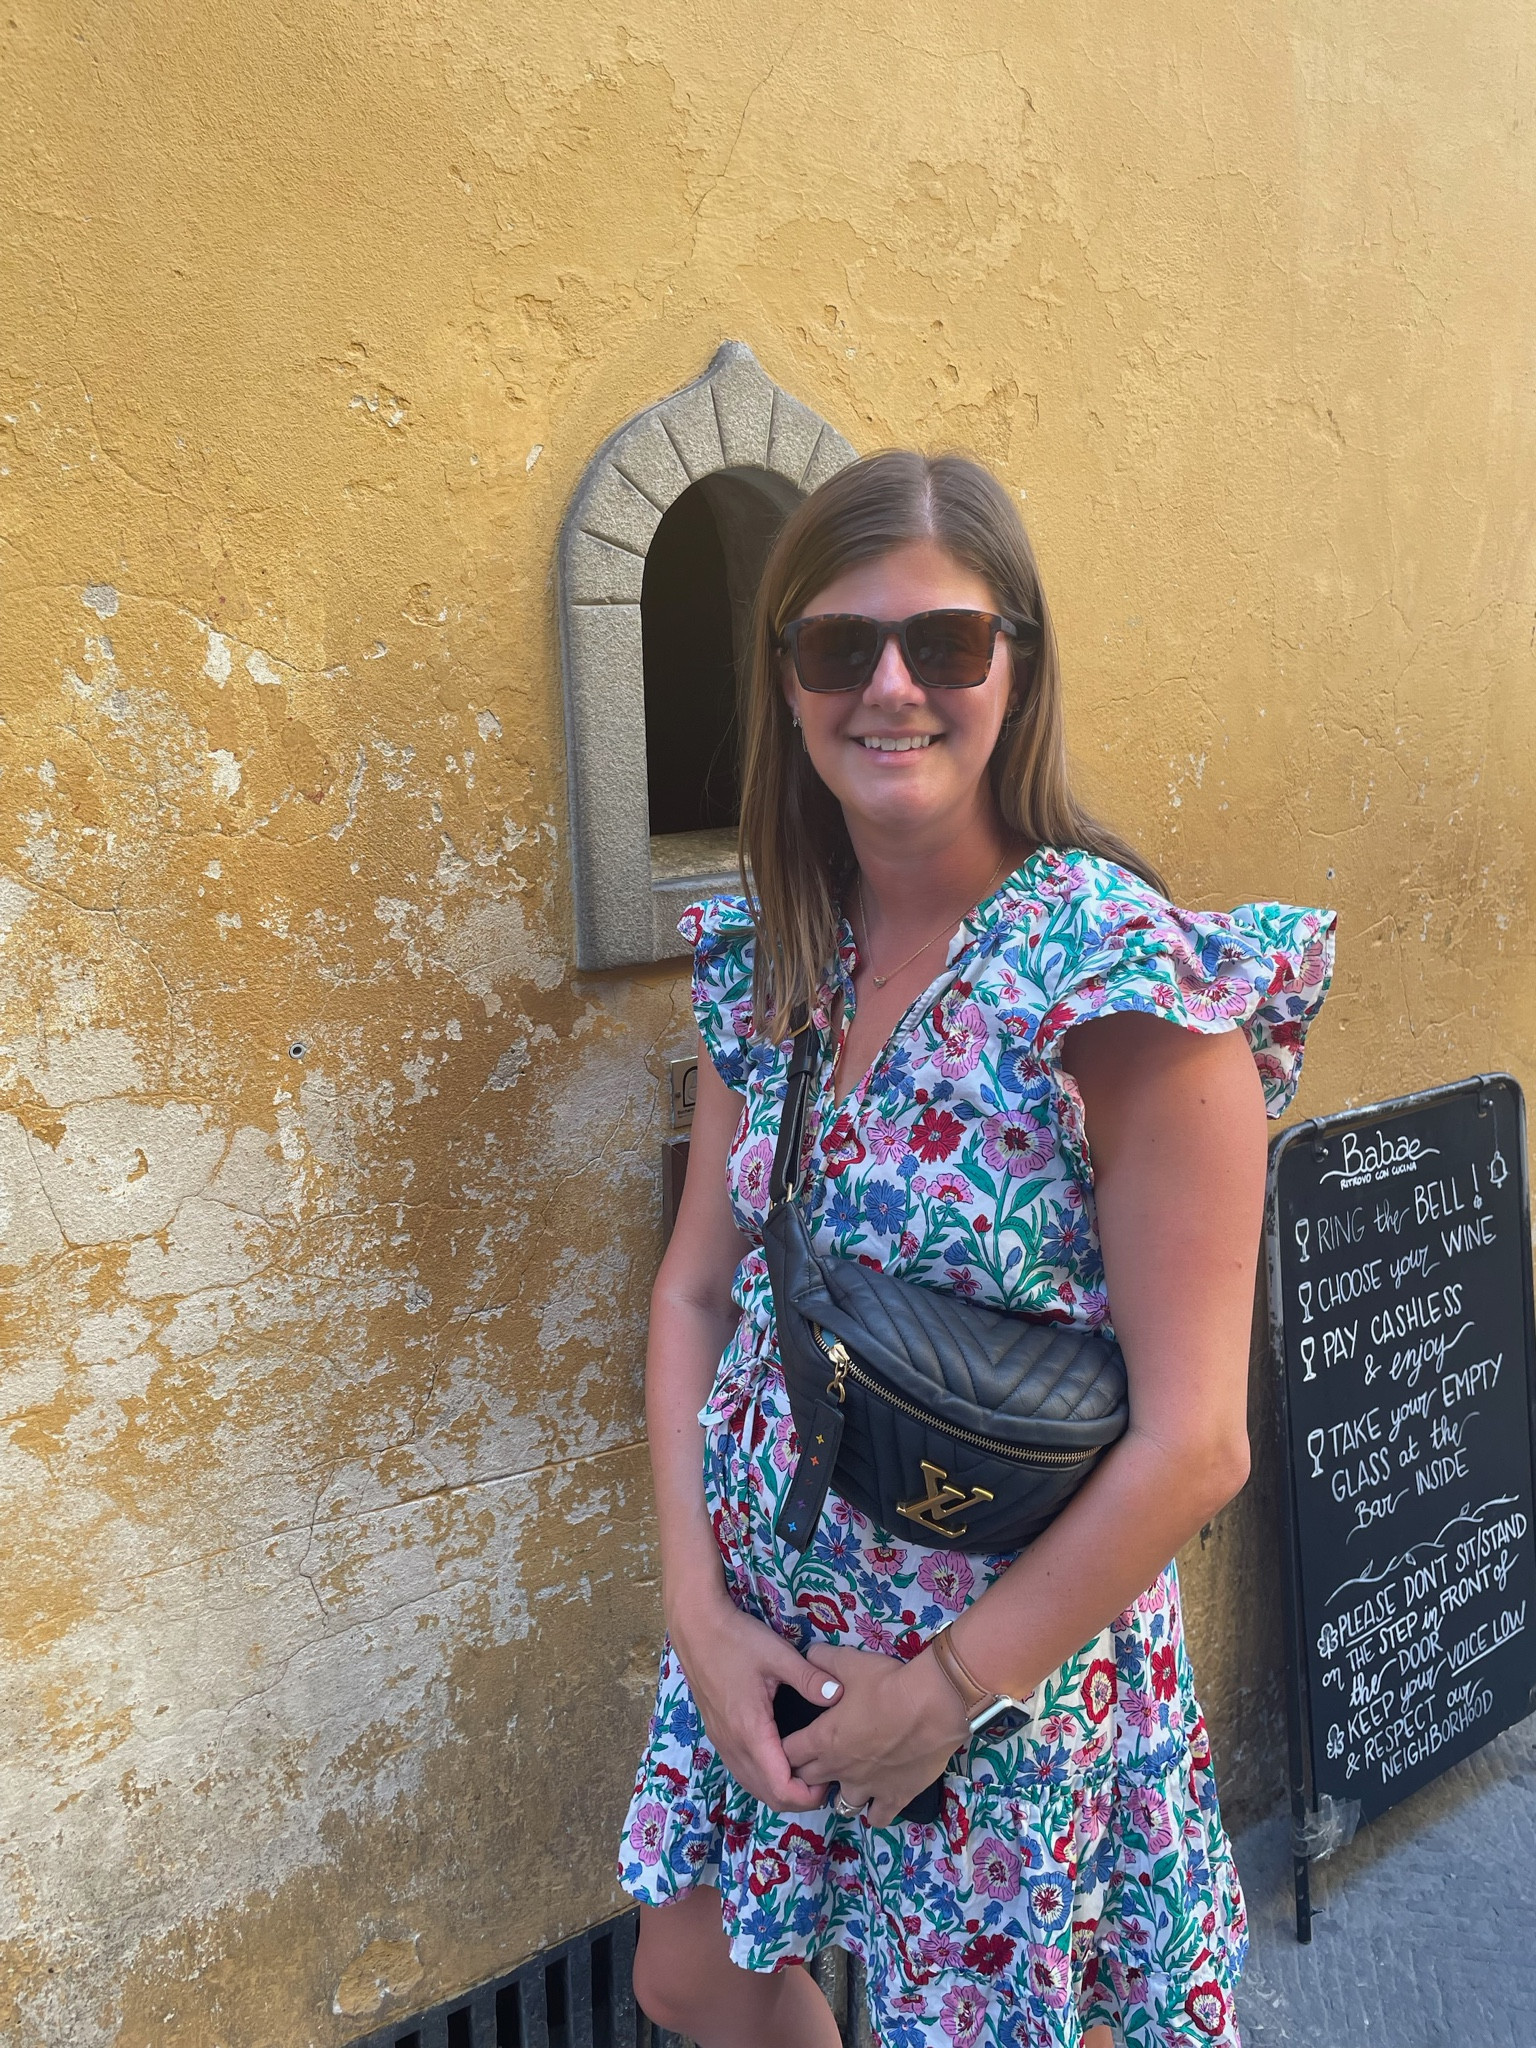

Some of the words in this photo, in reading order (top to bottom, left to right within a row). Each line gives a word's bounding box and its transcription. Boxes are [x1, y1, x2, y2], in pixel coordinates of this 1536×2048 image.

[1326, 1130, 1440, 1180] Babae
[1340, 1173, 1372, 1191] RITROVO
[1375, 1168, 1390, 1181] CON
[1392, 1161, 1417, 1176] CUCINA
[1317, 1207, 1364, 1254] RING
[1374, 1199, 1409, 1235] the
[1317, 1258, 1383, 1312] CHOOSE
[1390, 1244, 1441, 1289] your
[1440, 1215, 1497, 1257] WINE
[1322, 1319, 1358, 1368] PAY
[1371, 1283, 1463, 1344] CASHLESS
[1364, 1354, 1382, 1386] &
[1388, 1322, 1472, 1388] enjoy
[1327, 1407, 1382, 1457] TAKE
[1388, 1388, 1437, 1442] your
[1441, 1352, 1503, 1408] EMPTY
[1331, 1446, 1391, 1502] GLASS
[1399, 1435, 1419, 1467] at
[1430, 1411, 1480, 1449] the
[1349, 1488, 1409, 1538] Bar
[1415, 1448, 1469, 1496] INSIDE
[1321, 1666, 1345, 1691] on
[1345, 1641, 1375, 1673] THE
[1379, 1611, 1418, 1653] STEP
[1421, 1605, 1444, 1634] in
[1439, 1567, 1490, 1617] FRONT
[1493, 1549, 1519, 1591] of
[1337, 1583, 1397, 1646] PLEASE
[1455, 1512, 1527, 1573] SIT/STAND
[1347, 1690, 1394, 1744] KEEP
[1400, 1658, 1447, 1712] your
[1447, 1623, 1490, 1671] VOICE
[1492, 1599, 1526, 1644] LOW
[1349, 1658, 1397, 1708] the
[1398, 1630, 1444, 1676] DOOR
[1345, 1754, 1360, 1779] &
[1364, 1694, 1437, 1769] RESPECT
[1447, 1677, 1484, 1708] our
[1380, 1688, 1494, 1784] NEIGHBORHOOD
